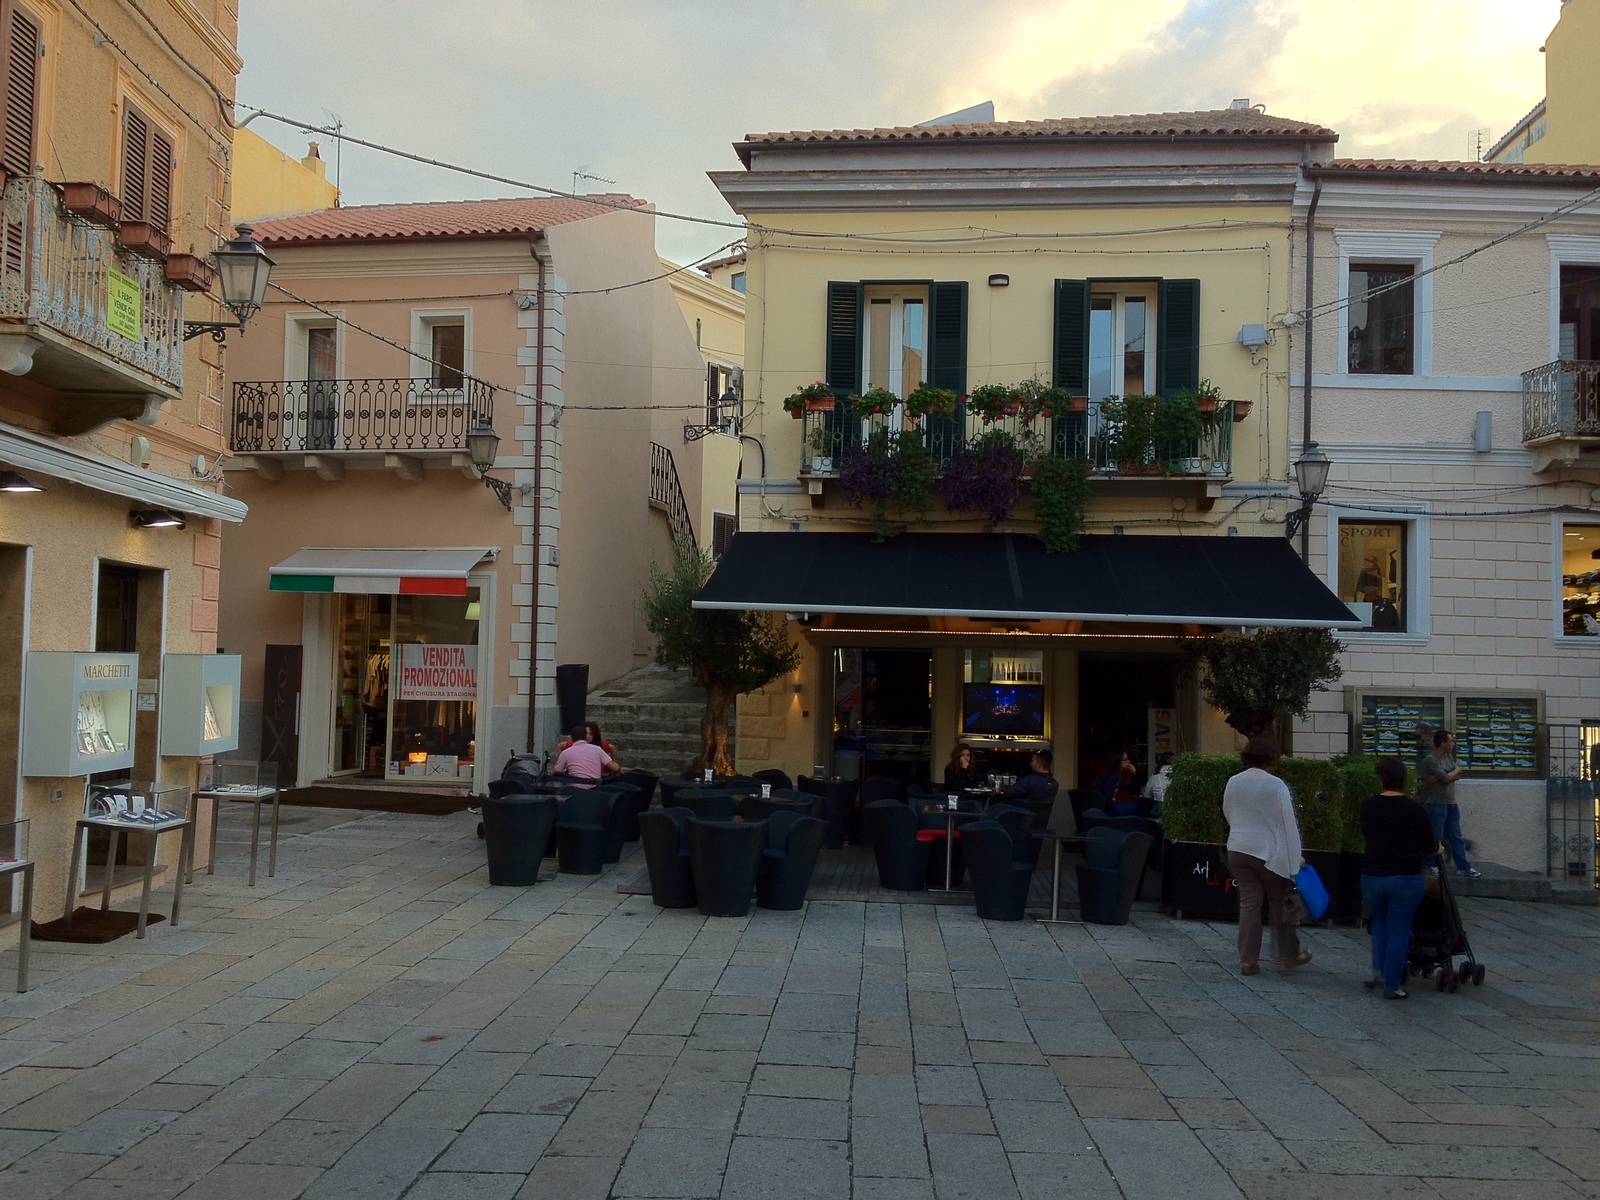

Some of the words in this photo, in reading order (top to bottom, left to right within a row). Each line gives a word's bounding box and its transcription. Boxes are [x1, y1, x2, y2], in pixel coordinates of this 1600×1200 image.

[122, 291, 133, 305] FARO
[114, 298, 128, 314] VENDE
[128, 306, 136, 317] QUI
[1341, 527, 1394, 538] SPORT
[422, 647, 466, 667] VENDITA
[84, 664, 130, 678] MARCHETTI
[403, 667, 478, 688] PROMOZIONAL
